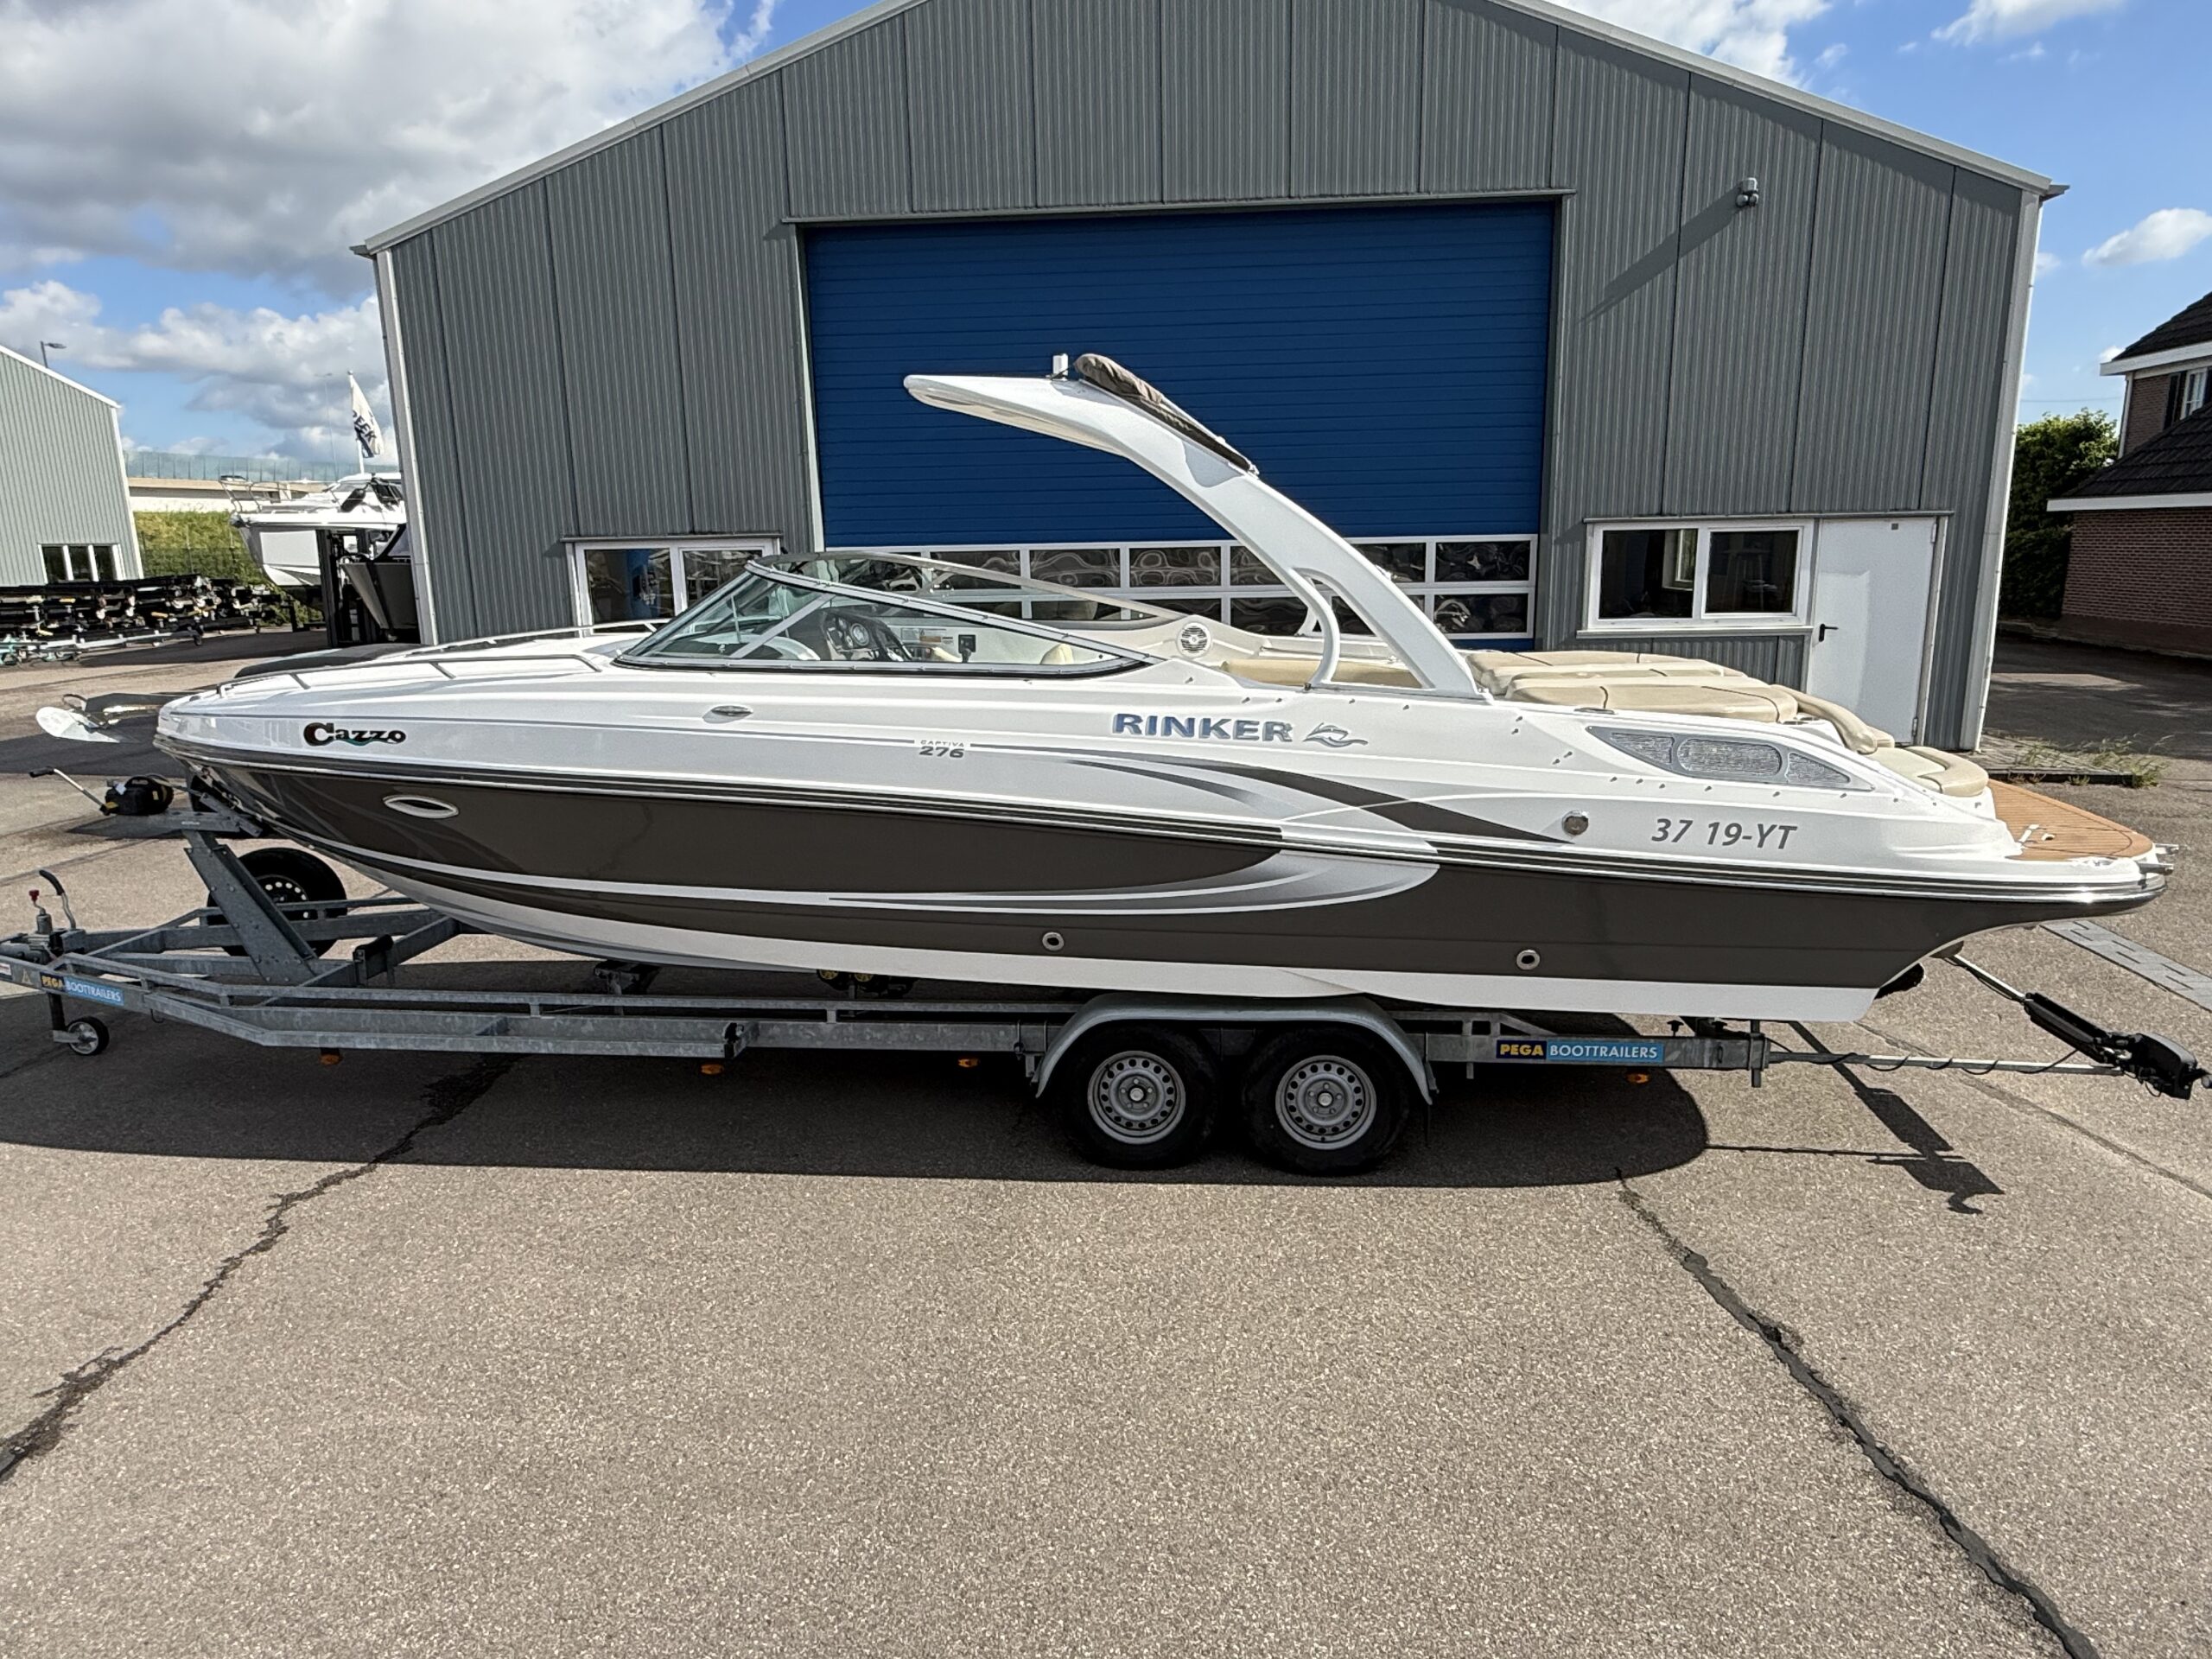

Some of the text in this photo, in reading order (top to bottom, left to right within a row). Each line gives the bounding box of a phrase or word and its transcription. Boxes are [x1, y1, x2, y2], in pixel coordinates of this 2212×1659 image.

[303, 722, 406, 747] Cazzo
[1112, 713, 1293, 742] RINKER
[918, 746, 964, 759] 276
[1651, 817, 1798, 849] 37 19-YT
[41, 975, 122, 1002] PEGA BOOTTRAILERS
[1499, 1044, 1657, 1058] PEGA BOOTTRAILERS
